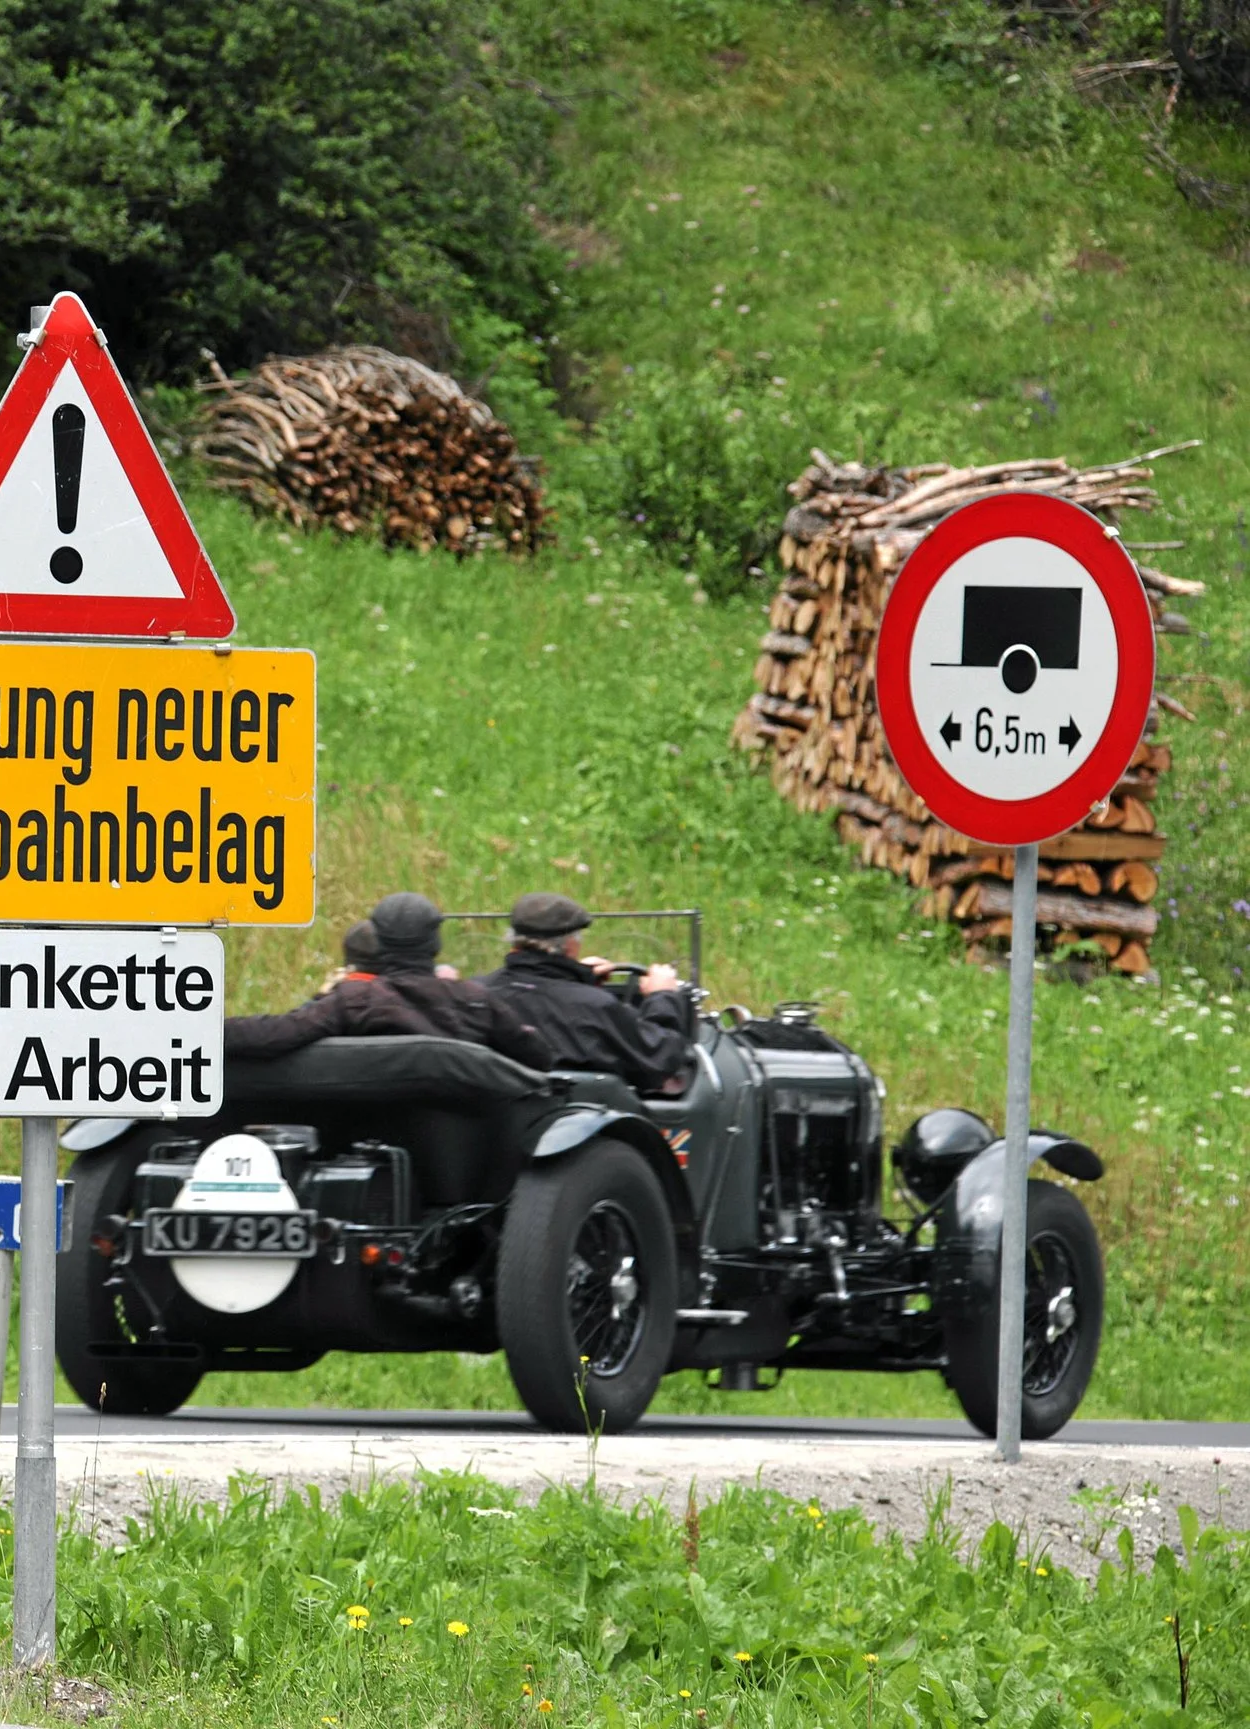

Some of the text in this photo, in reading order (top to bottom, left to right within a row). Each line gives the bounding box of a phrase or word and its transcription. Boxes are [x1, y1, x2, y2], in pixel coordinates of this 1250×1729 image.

[116, 687, 296, 763] neuer
[974, 706, 1047, 760] 6,5m
[3, 1036, 212, 1103] Arbeit
[151, 1215, 308, 1250] KU 7926
